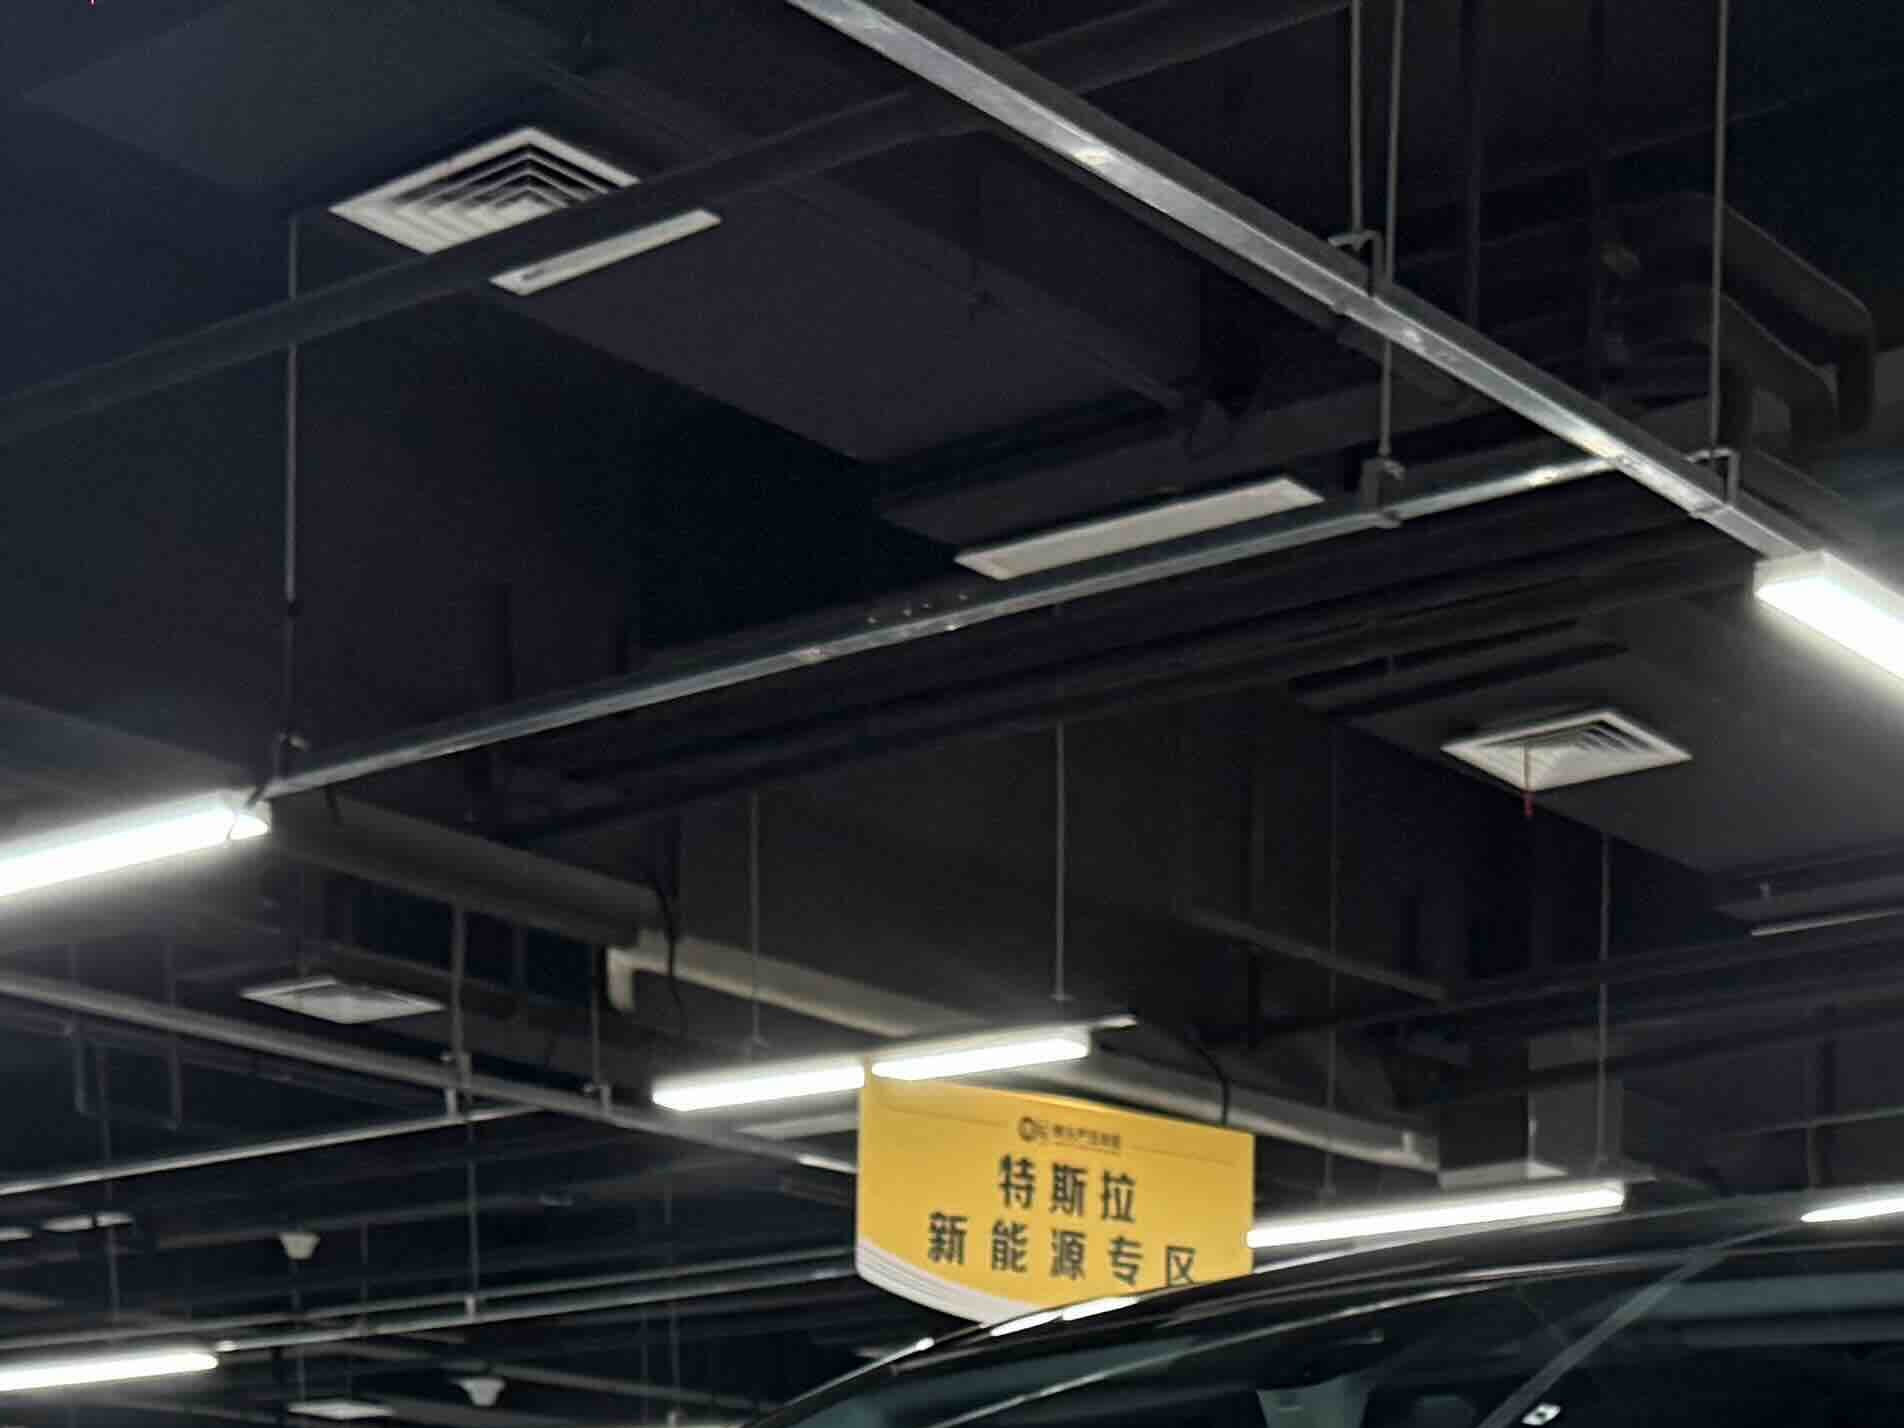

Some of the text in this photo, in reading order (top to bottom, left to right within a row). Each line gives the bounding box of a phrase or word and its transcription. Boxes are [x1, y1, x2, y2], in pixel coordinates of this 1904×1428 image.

[997, 1153, 1137, 1224] 特斯拉
[926, 1211, 1199, 1289] 新能源专区
